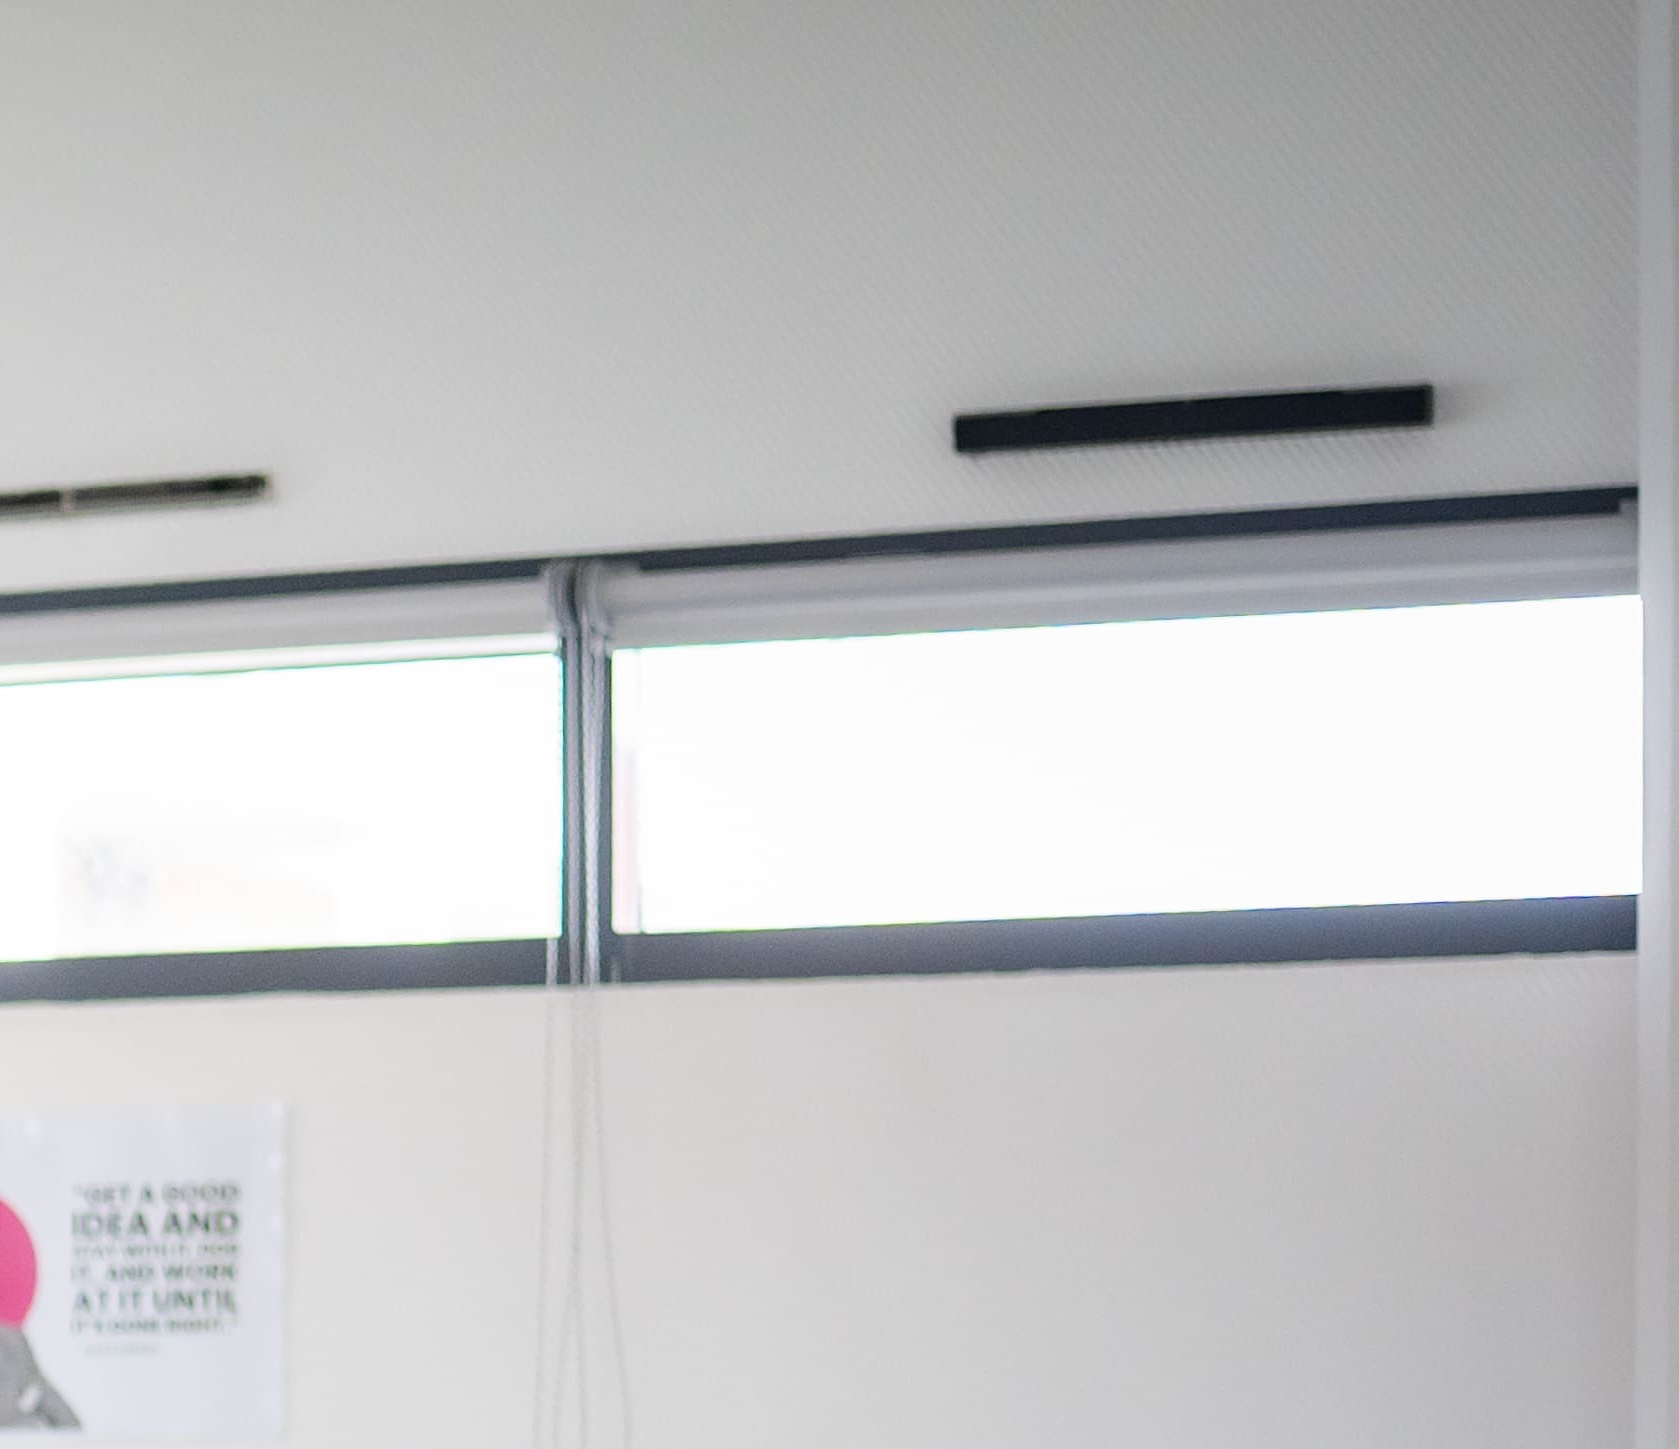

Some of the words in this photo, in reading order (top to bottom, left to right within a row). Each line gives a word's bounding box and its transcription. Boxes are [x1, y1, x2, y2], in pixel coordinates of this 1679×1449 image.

[140, 1184, 154, 1203] A
[161, 1182, 241, 1202] GOOD
[71, 1210, 149, 1236] IDEA
[161, 1209, 239, 1235] AND
[163, 1264, 236, 1280] WORK
[75, 1288, 109, 1313] AT
[118, 1288, 142, 1310] IT
[152, 1287, 237, 1315] UNTIL
